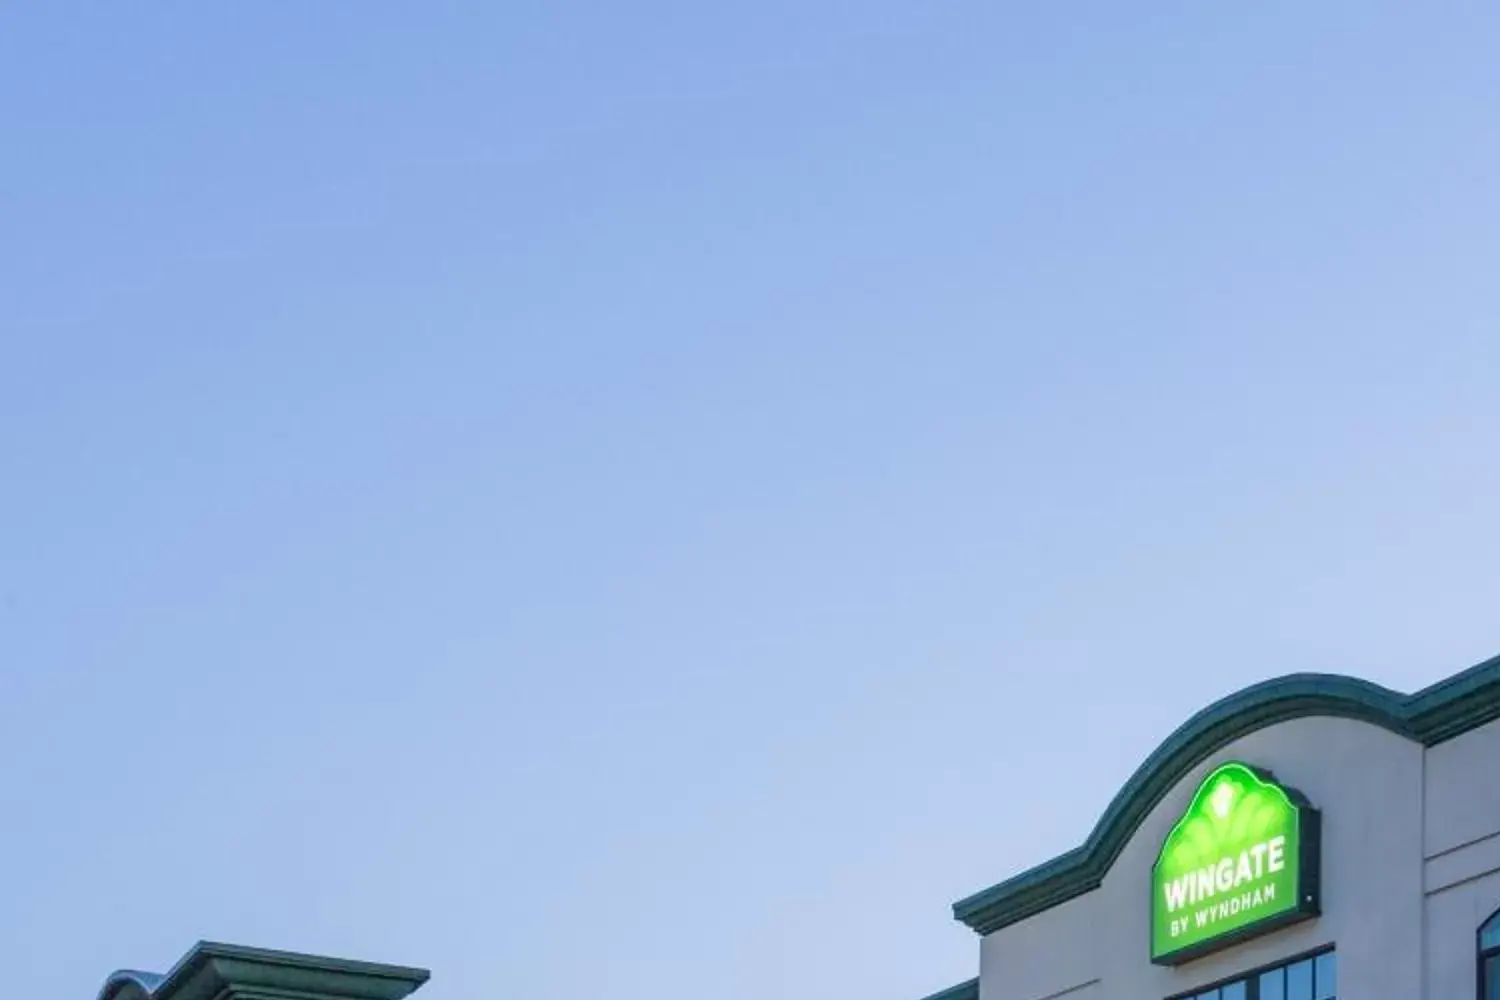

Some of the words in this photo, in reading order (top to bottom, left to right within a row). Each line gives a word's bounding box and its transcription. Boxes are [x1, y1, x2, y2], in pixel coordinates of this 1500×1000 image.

[1164, 835, 1285, 912] WINGATE
[1170, 917, 1188, 937] BY
[1195, 883, 1275, 928] WYNDHAM
